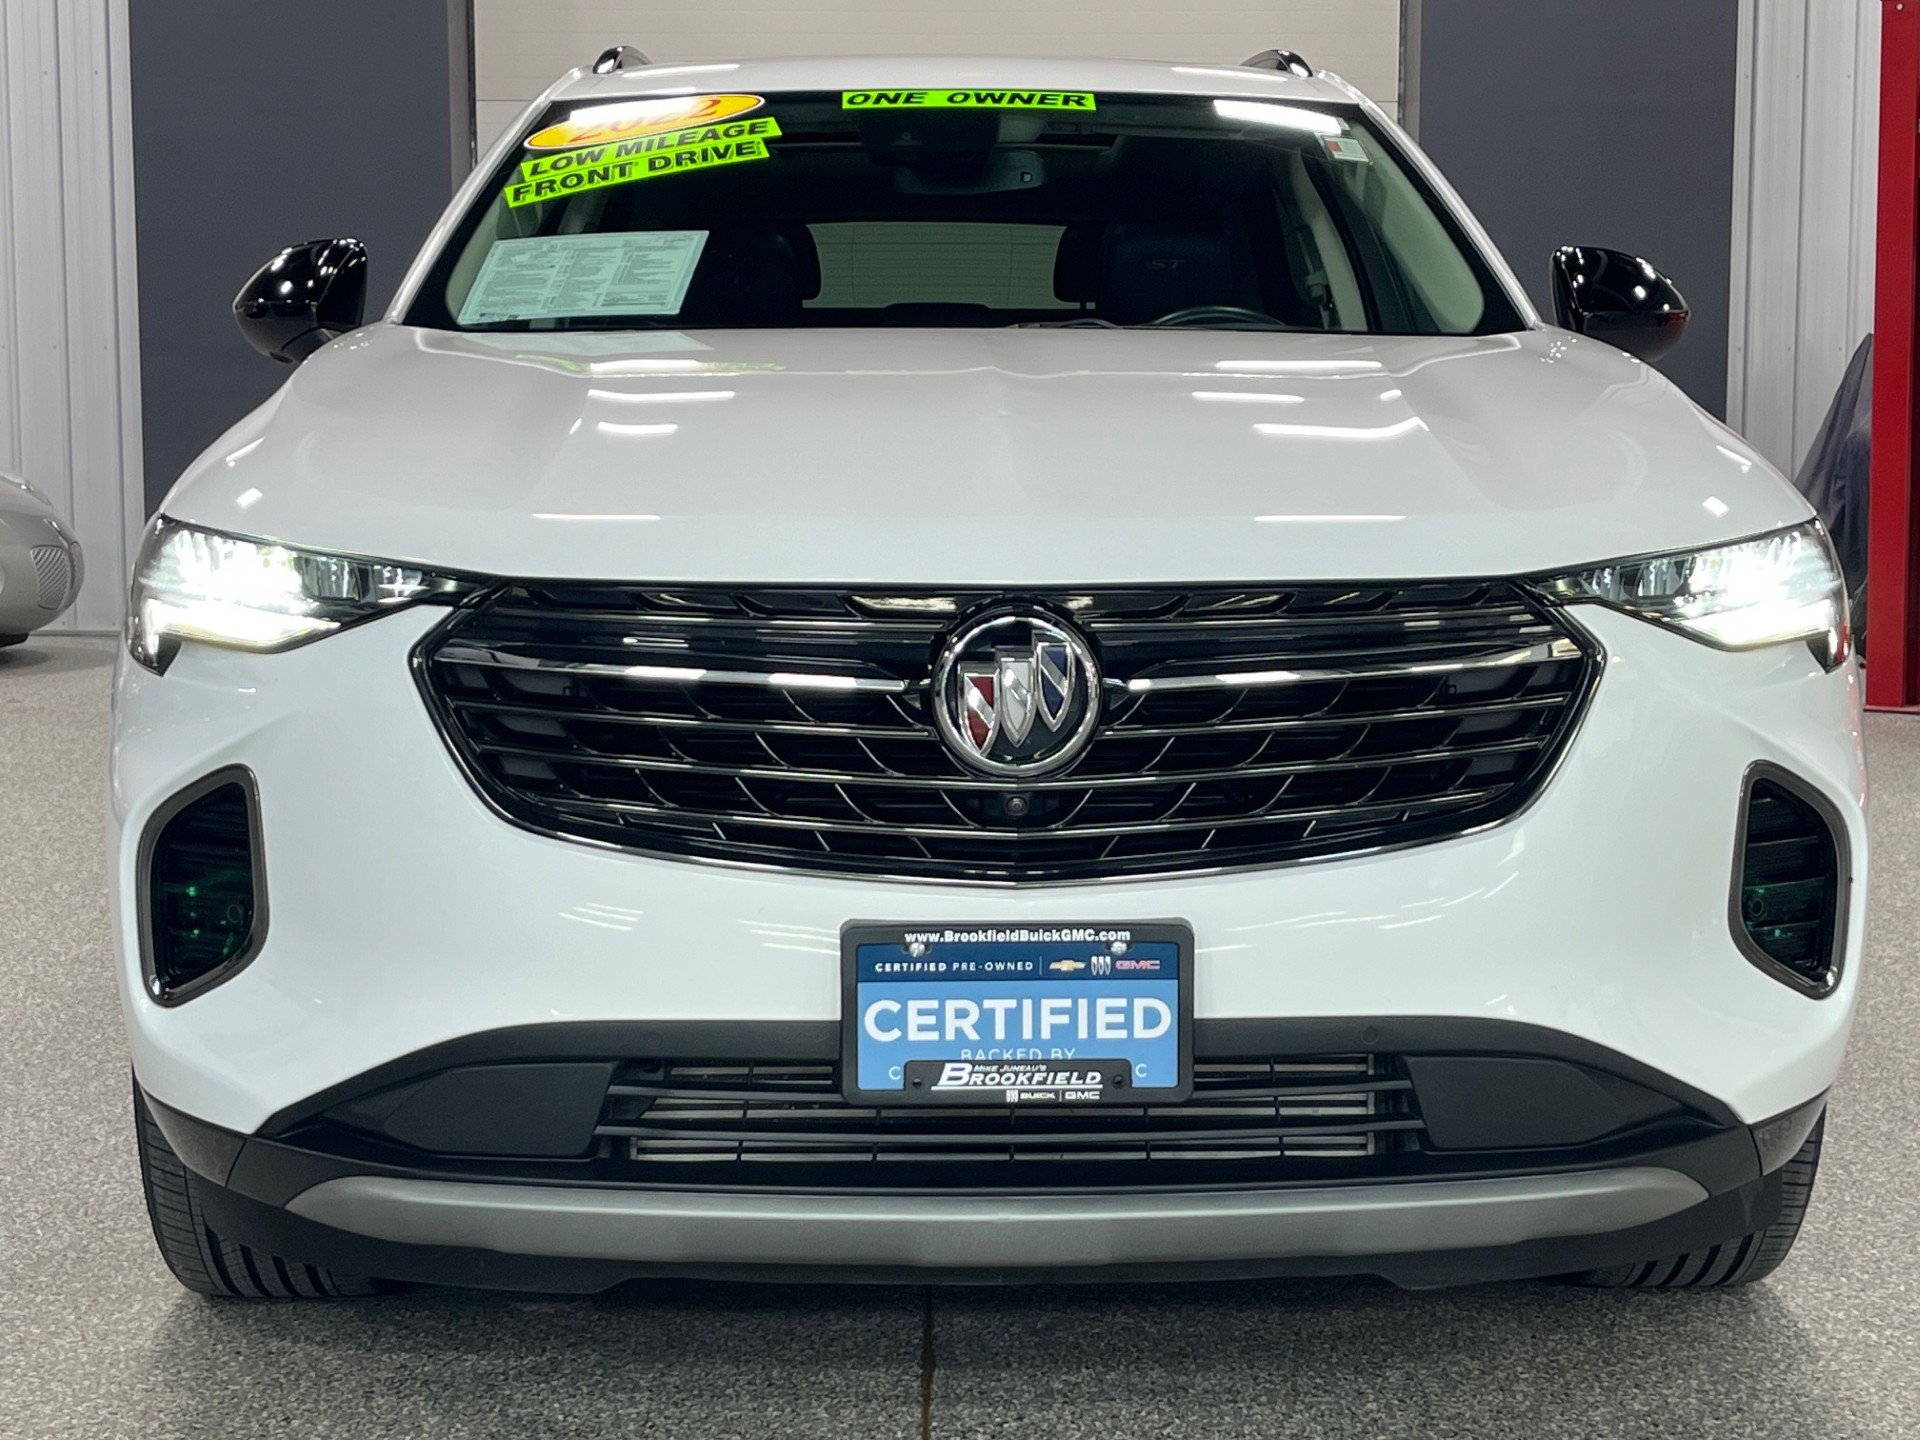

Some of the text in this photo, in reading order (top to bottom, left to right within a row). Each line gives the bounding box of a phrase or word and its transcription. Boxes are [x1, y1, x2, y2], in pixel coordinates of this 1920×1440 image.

[847, 92, 1088, 107] ONE OWNER
[529, 120, 770, 177] LOW MILEAGE
[512, 139, 761, 202] FRONT DRIVE
[904, 929, 1131, 943] www.BrookfieldBuickGMC.com
[875, 960, 1161, 973] CERTIFIED PRE-OWNED GMC
[864, 998, 1172, 1042] CERTIFIED
[960, 1048, 1077, 1060] BACKED BY
[938, 1063, 1102, 1086] BROOKFIELD
[973, 1064, 998, 1072] MIKE
[1020, 1091, 1101, 1100] BUICK GMC
